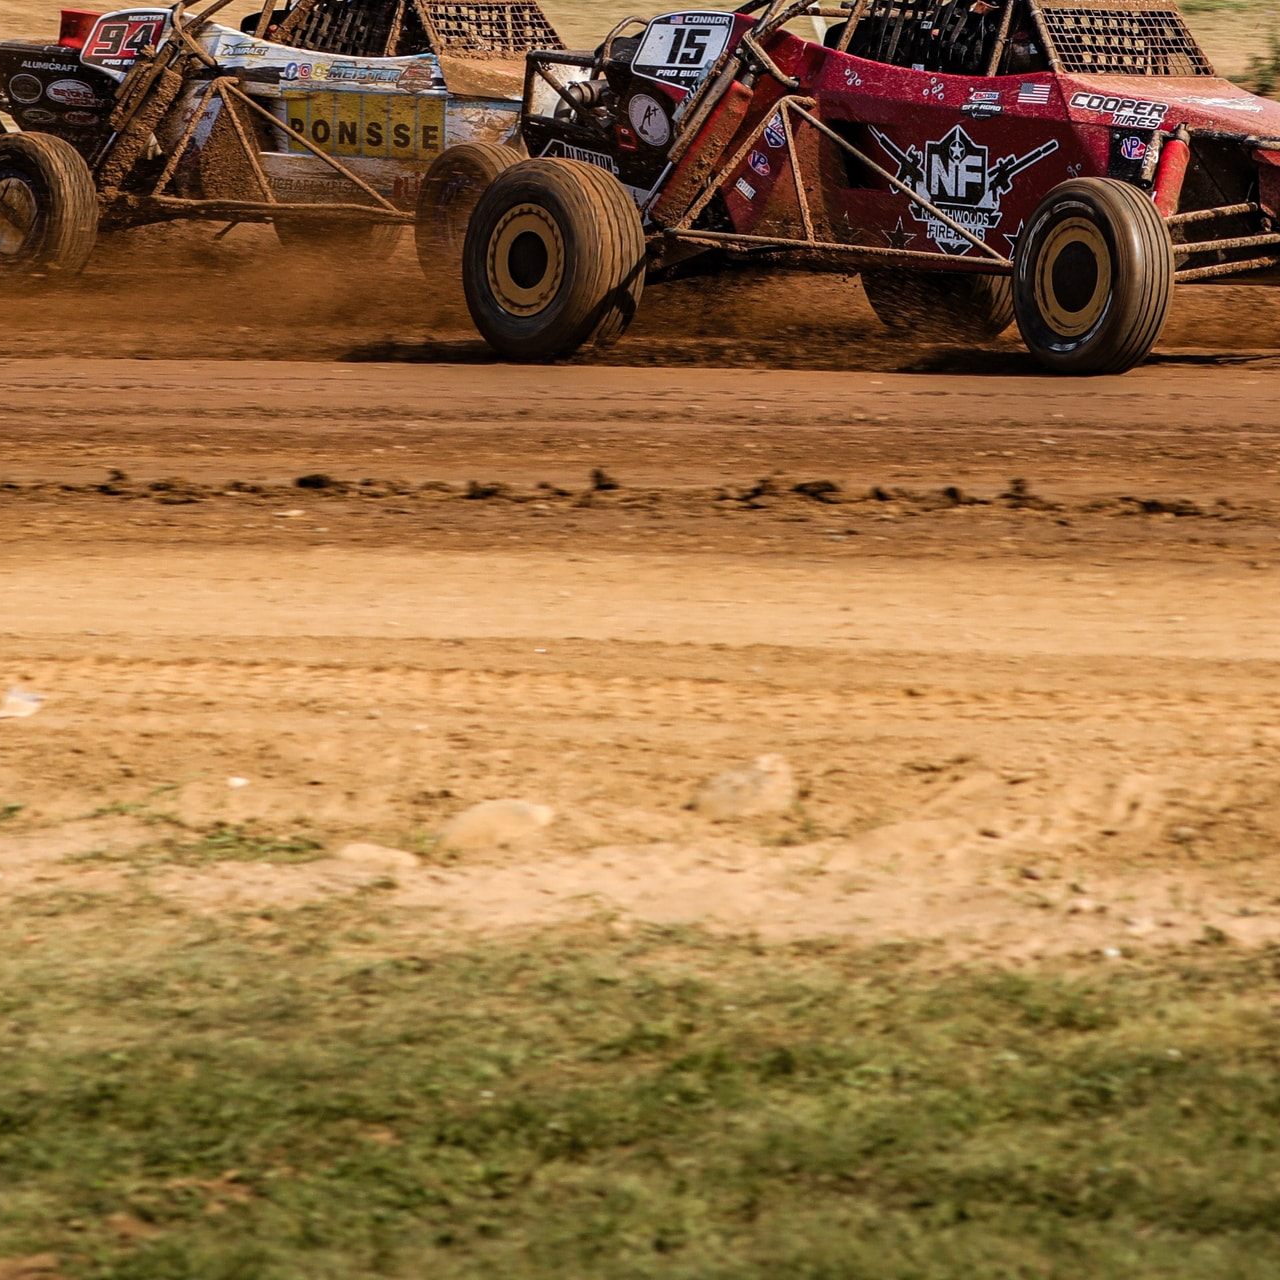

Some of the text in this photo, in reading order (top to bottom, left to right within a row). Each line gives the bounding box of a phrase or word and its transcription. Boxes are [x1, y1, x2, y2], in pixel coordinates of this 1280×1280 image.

[684, 15, 730, 24] CONNOR
[92, 23, 156, 56] 94
[666, 28, 710, 65] 15
[233, 46, 268, 56] IMPACT
[21, 60, 79, 72] ALUMICRAFT
[327, 68, 401, 83] MEISTER
[1070, 93, 1168, 117] COOPER
[1112, 114, 1161, 129] TIRES
[290, 118, 439, 149] PONSSE
[930, 153, 983, 198] NF
